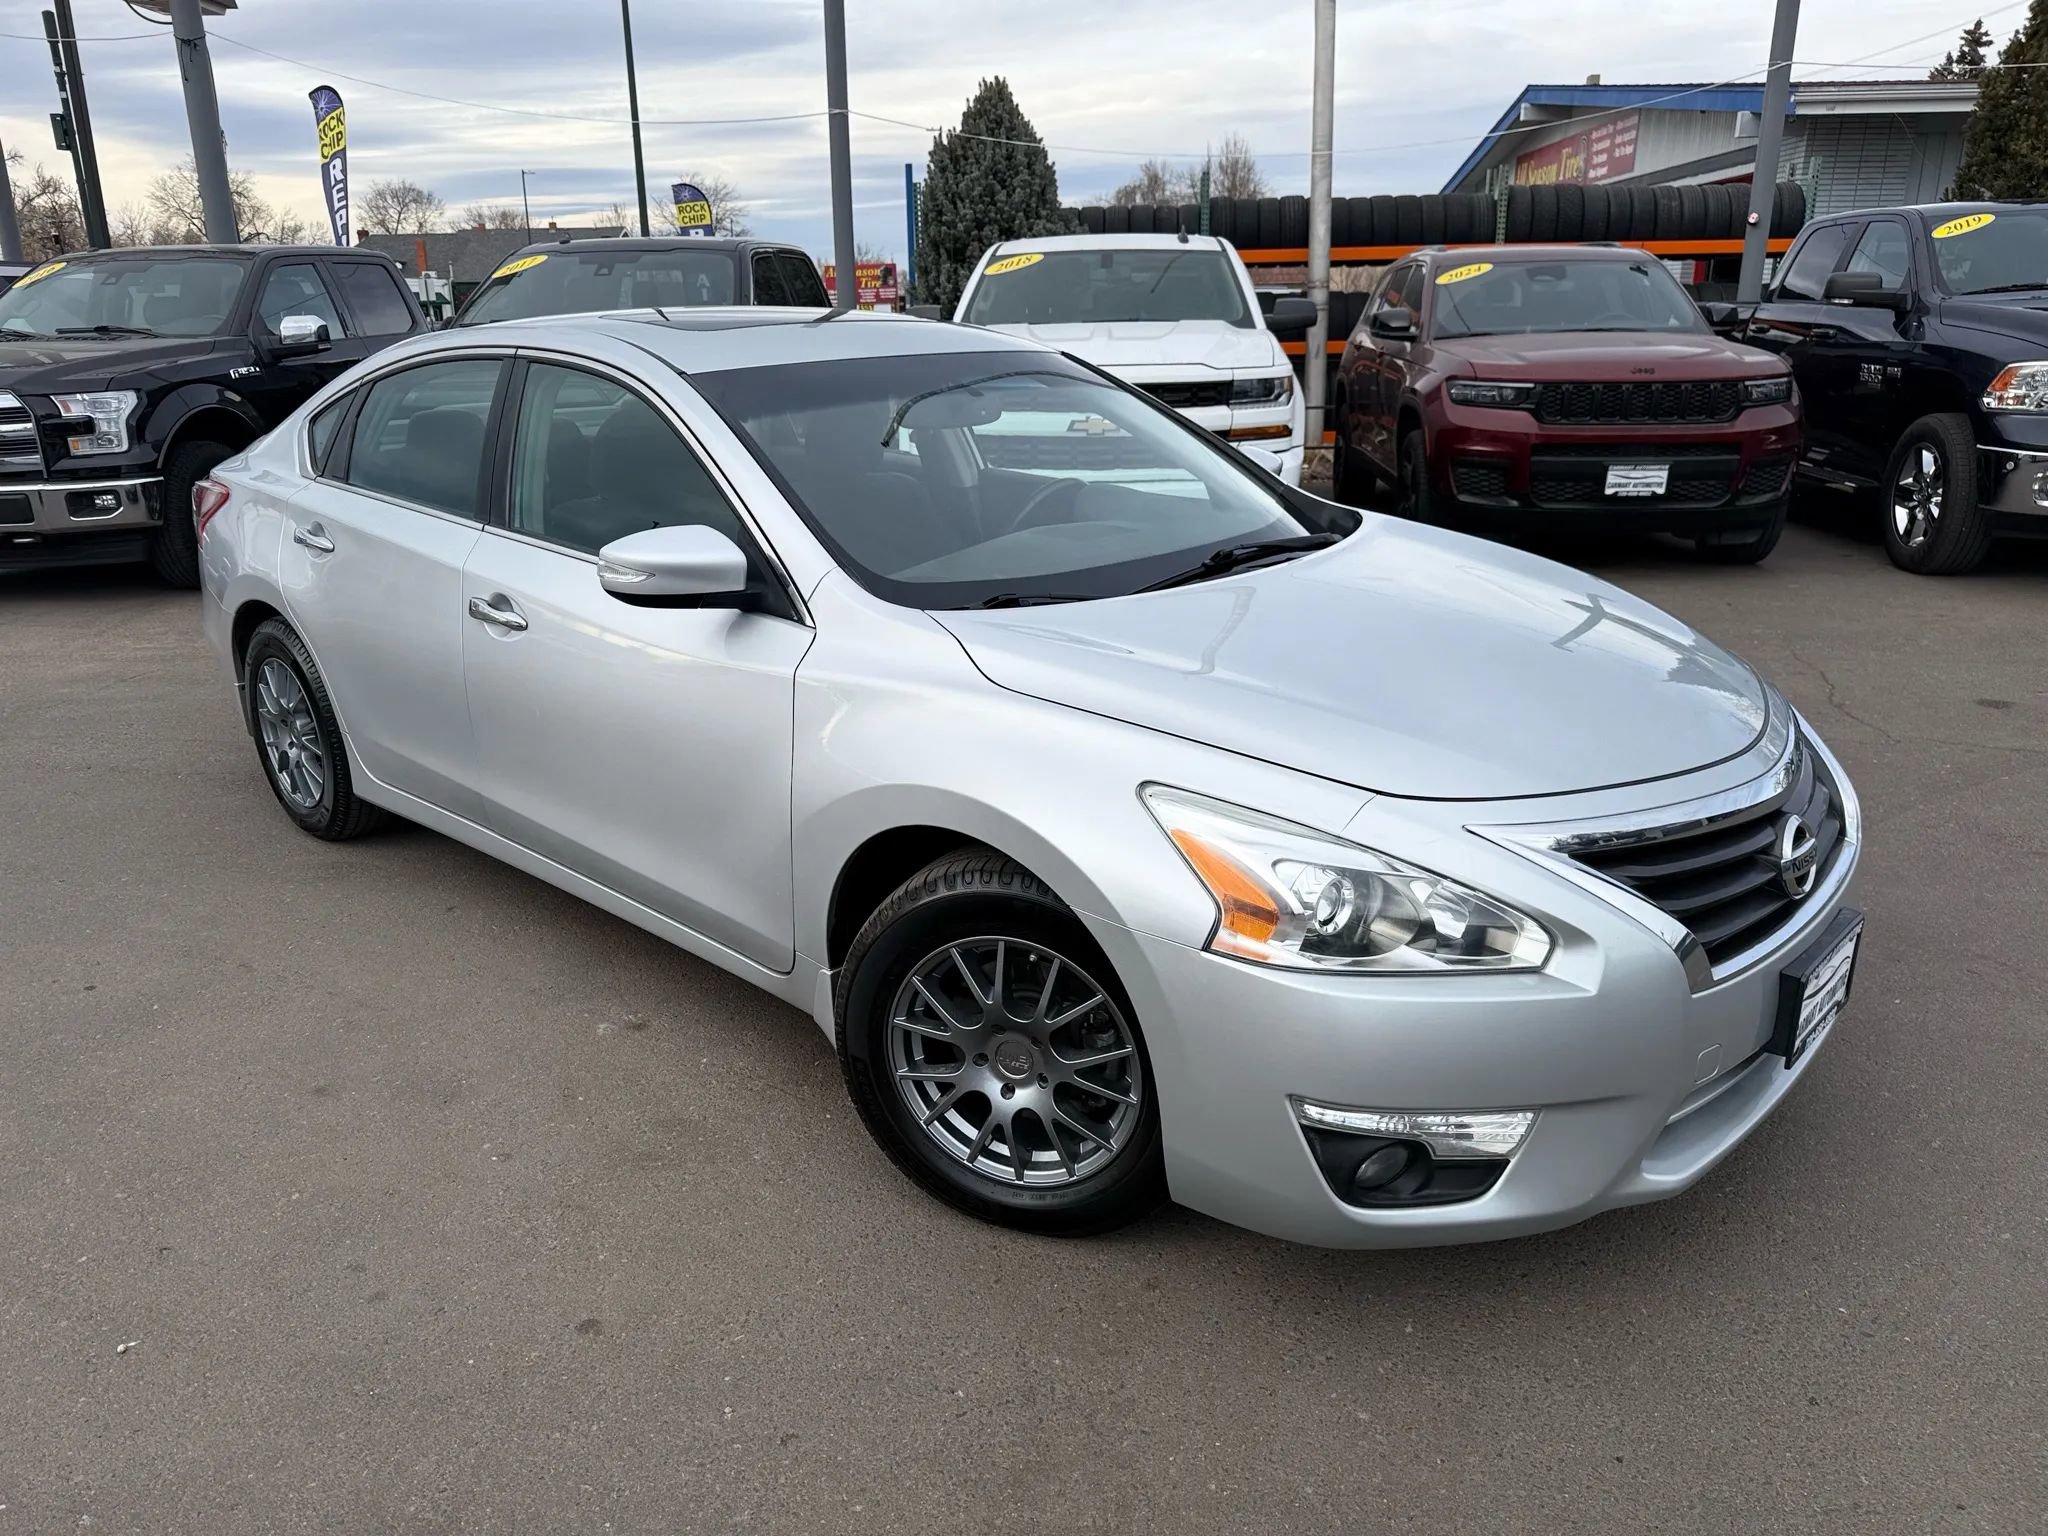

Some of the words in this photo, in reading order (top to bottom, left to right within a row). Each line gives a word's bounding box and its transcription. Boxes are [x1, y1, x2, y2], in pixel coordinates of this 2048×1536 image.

[319, 111, 344, 141] ROCK
[320, 130, 343, 159] CHIP
[678, 203, 707, 215] ROCK
[681, 214, 706, 225] CHIP
[1944, 215, 1982, 234] 2019
[500, 256, 537, 276] 2017
[995, 255, 1033, 272] 2018
[1447, 265, 1482, 281] 2024
[1798, 1000, 1820, 1033] ARMART
